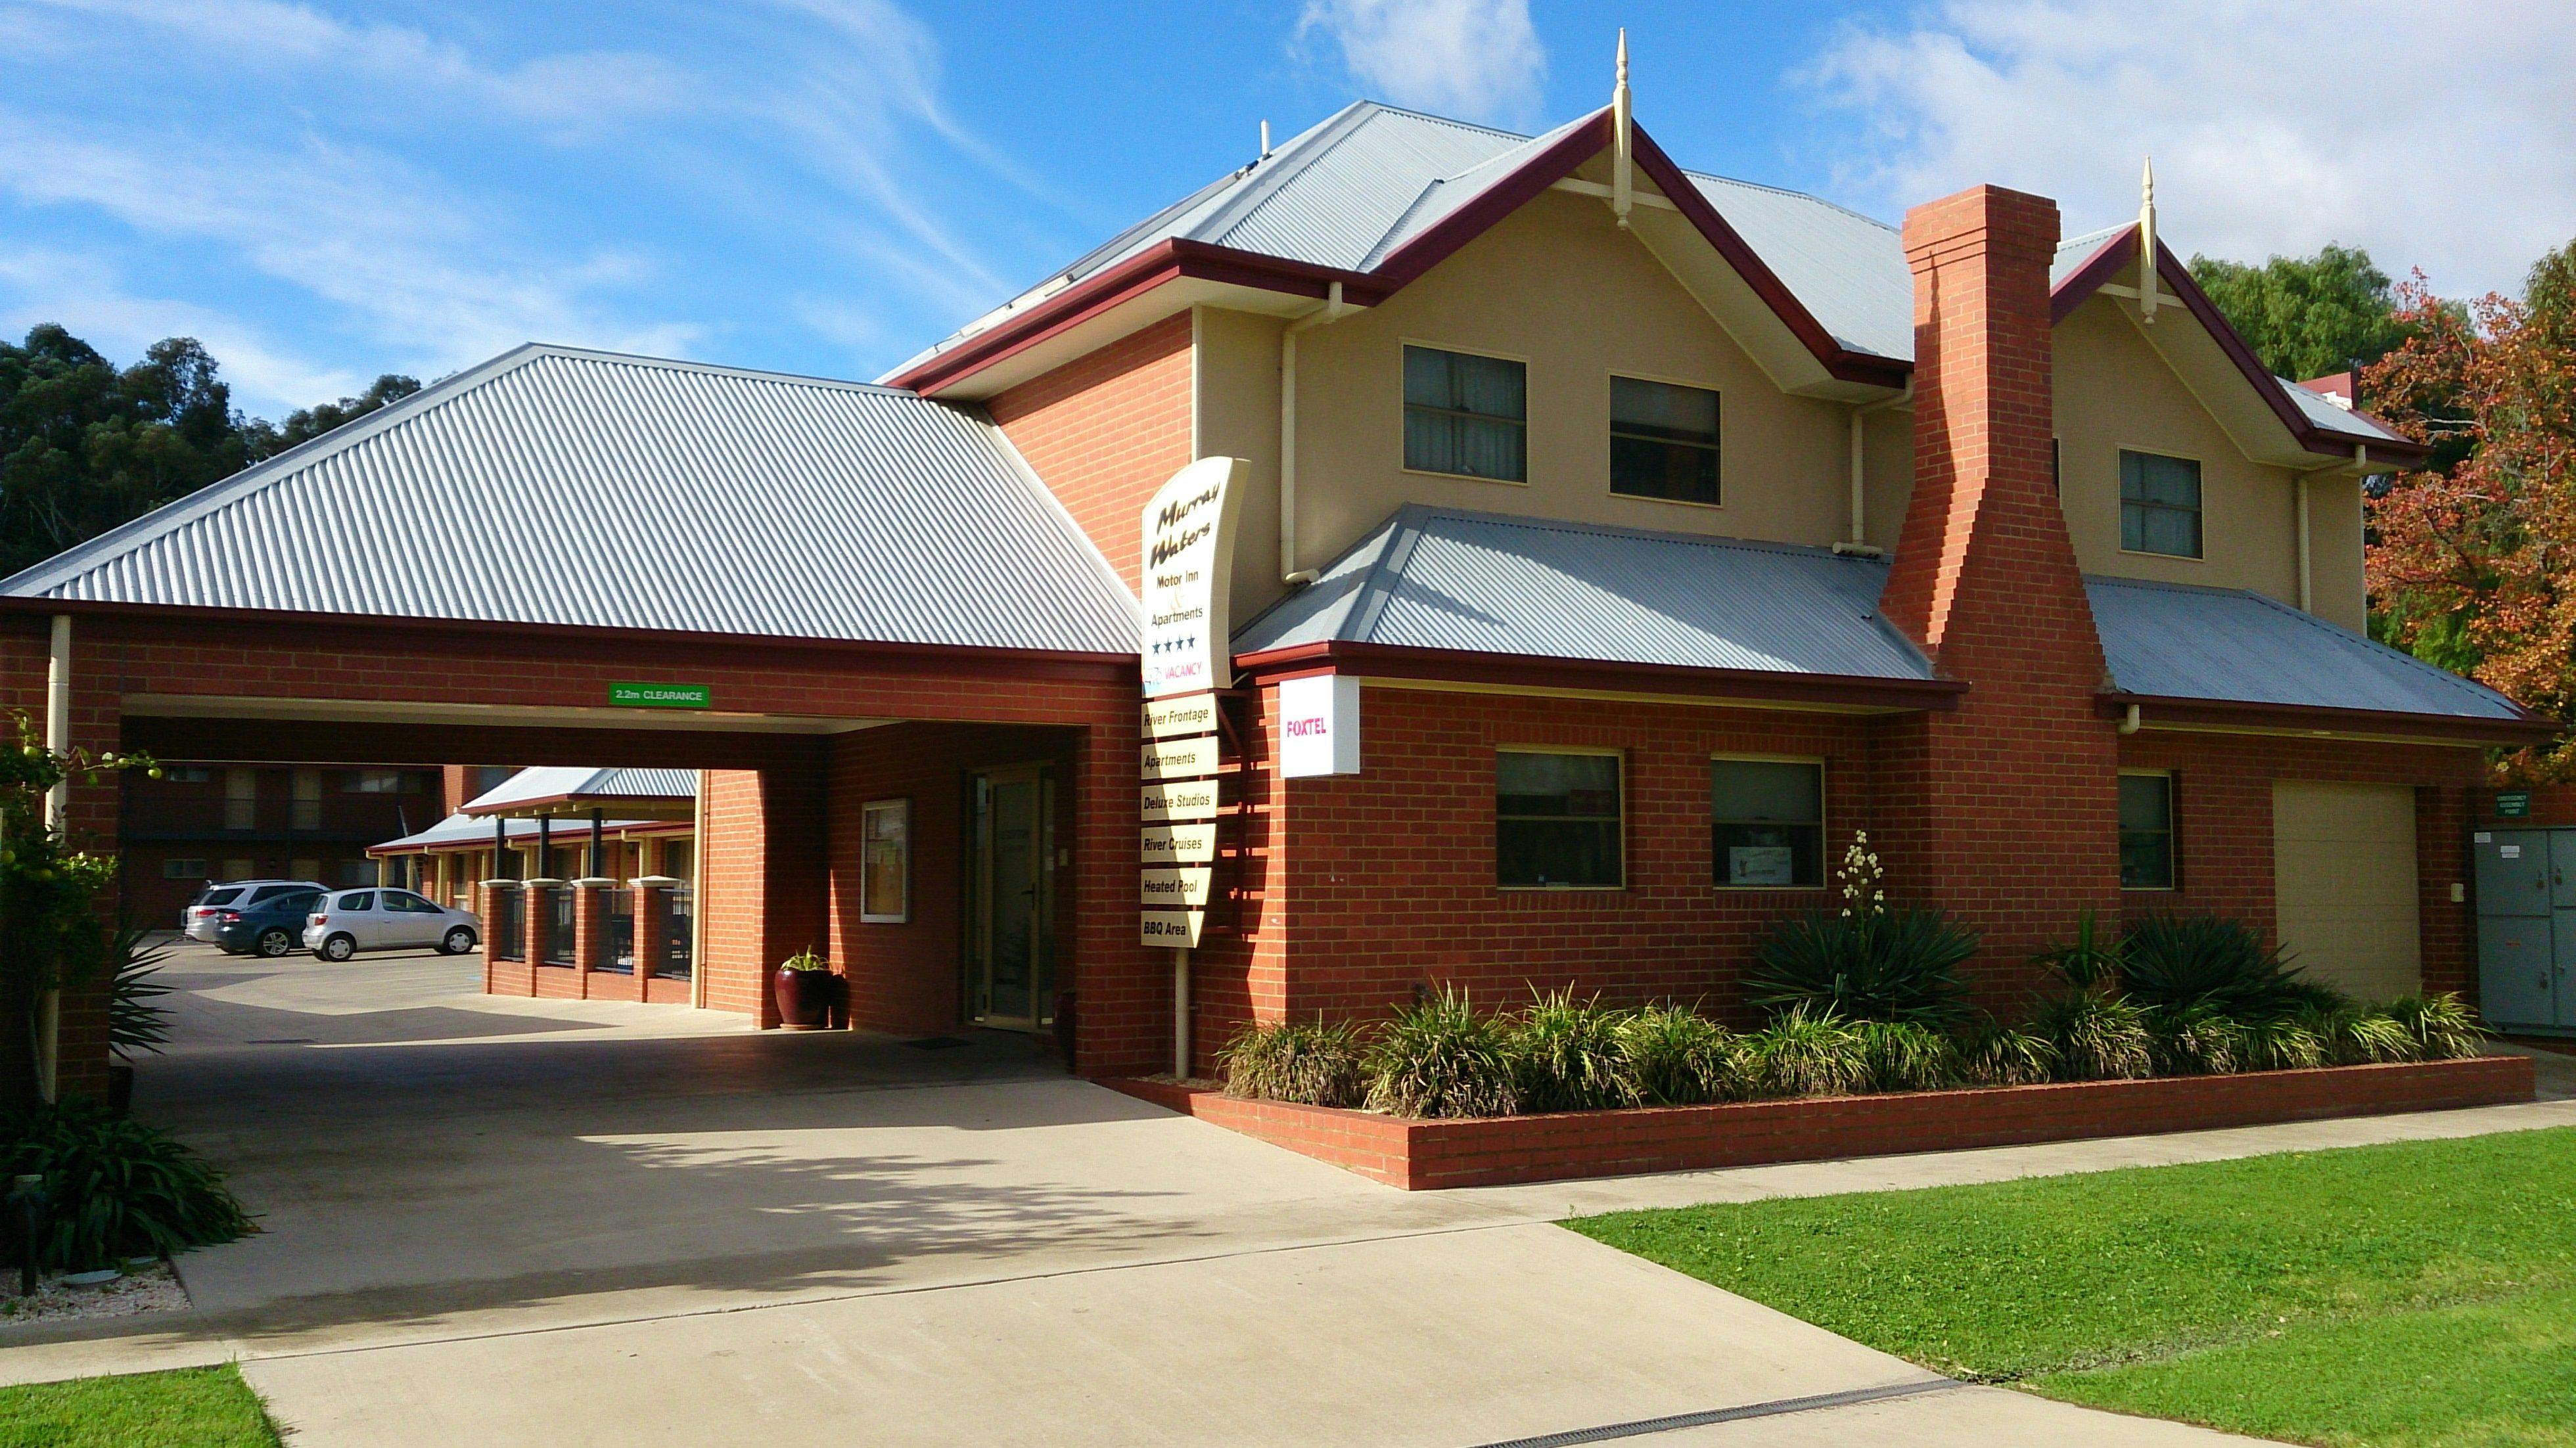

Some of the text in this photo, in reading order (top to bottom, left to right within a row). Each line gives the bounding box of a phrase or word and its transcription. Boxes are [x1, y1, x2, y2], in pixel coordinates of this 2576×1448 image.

[1157, 481, 1220, 535] Murray
[1150, 522, 1210, 570] Waters
[1157, 570, 1199, 589] Motor Inn
[1151, 606, 1203, 629] Apartments
[1164, 661, 1202, 679] VACANCY
[616, 689, 702, 701] 2.2m CLEARANCE
[1143, 709, 1208, 727] River Frontage
[1287, 717, 1326, 737] FOXTEL
[1143, 752, 1196, 770] Apartments
[1143, 792, 1210, 809] Deluxe Studios
[1143, 837, 1203, 851] River Cruises
[1143, 880, 1197, 892] Heated Pool
[1143, 922, 1186, 936] BBQ Area
